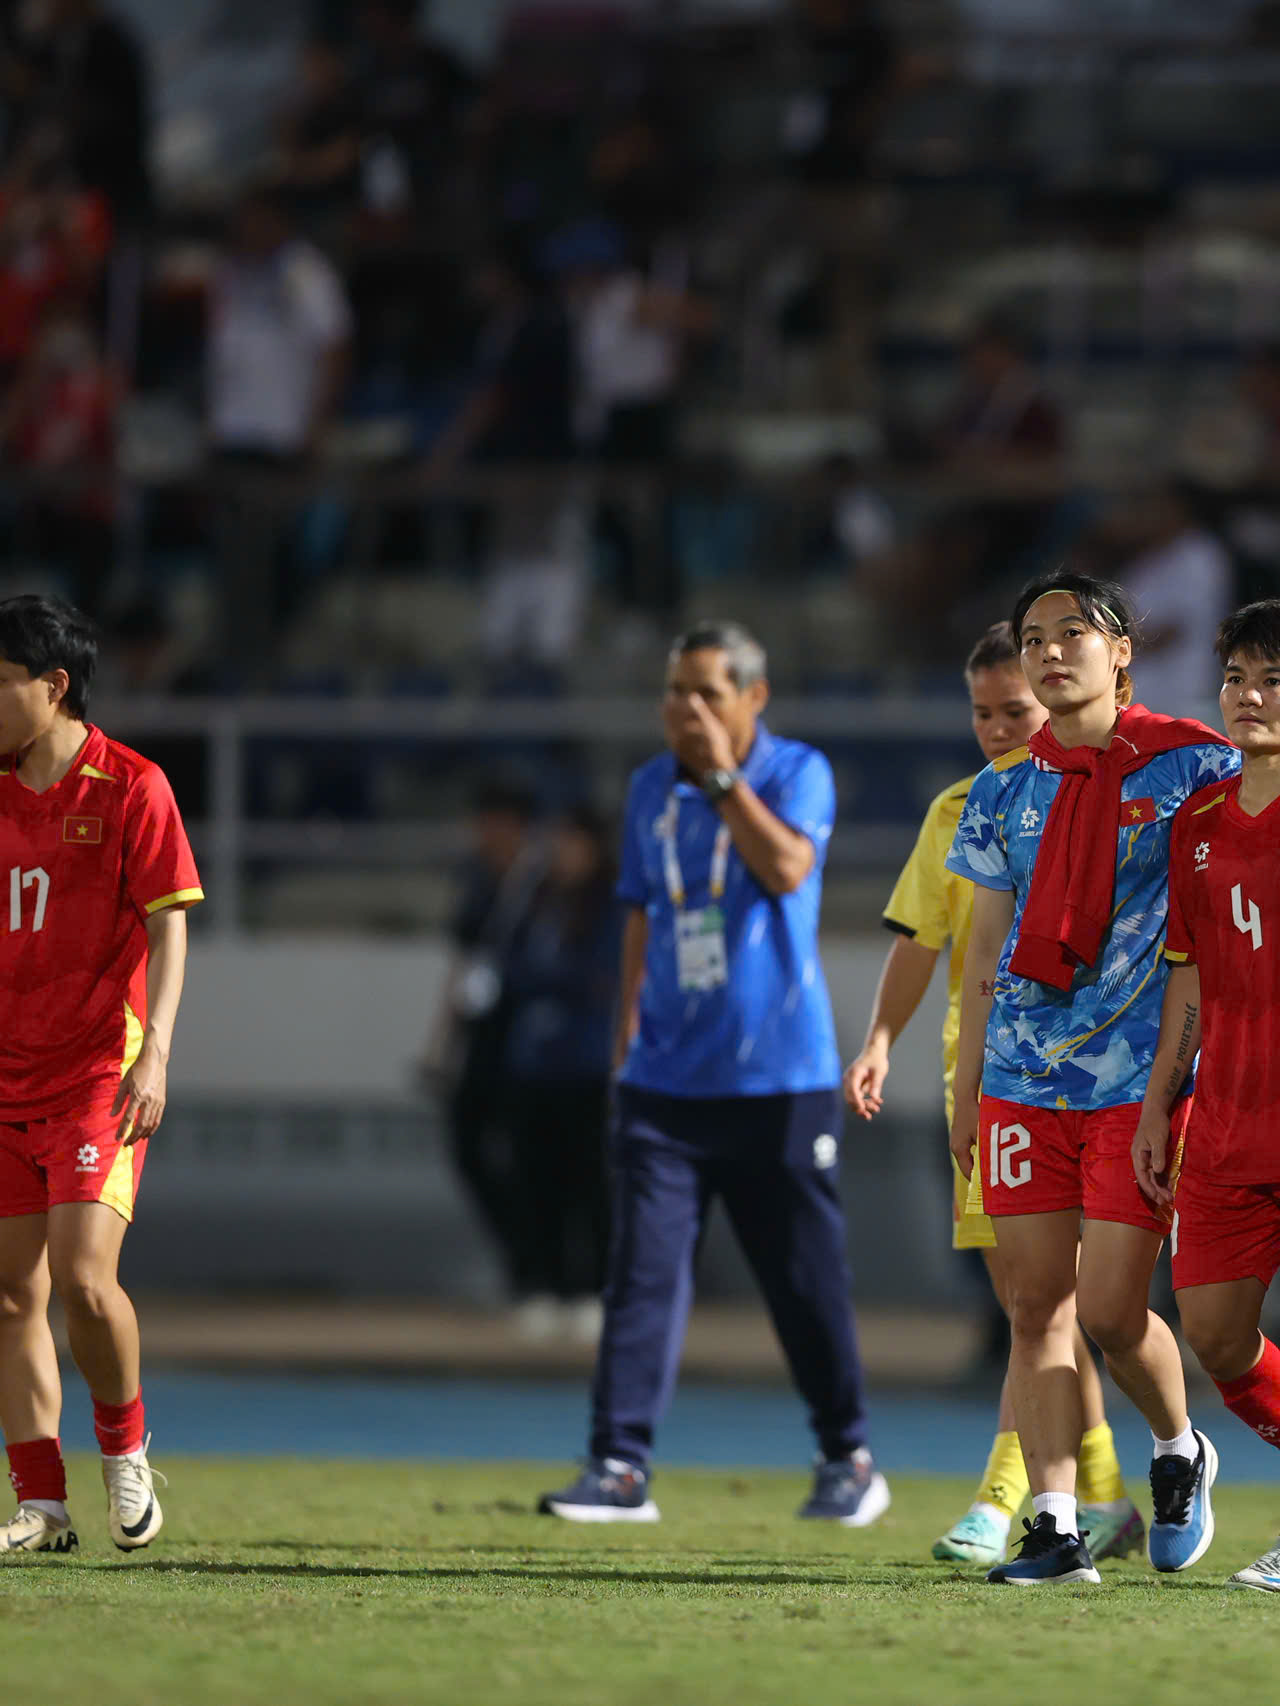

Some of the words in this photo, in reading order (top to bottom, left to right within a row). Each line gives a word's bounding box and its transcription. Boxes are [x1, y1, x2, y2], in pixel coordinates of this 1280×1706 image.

[9, 865, 51, 933] 17
[1230, 883, 1263, 951] 4
[989, 1121, 1032, 1189] 12
